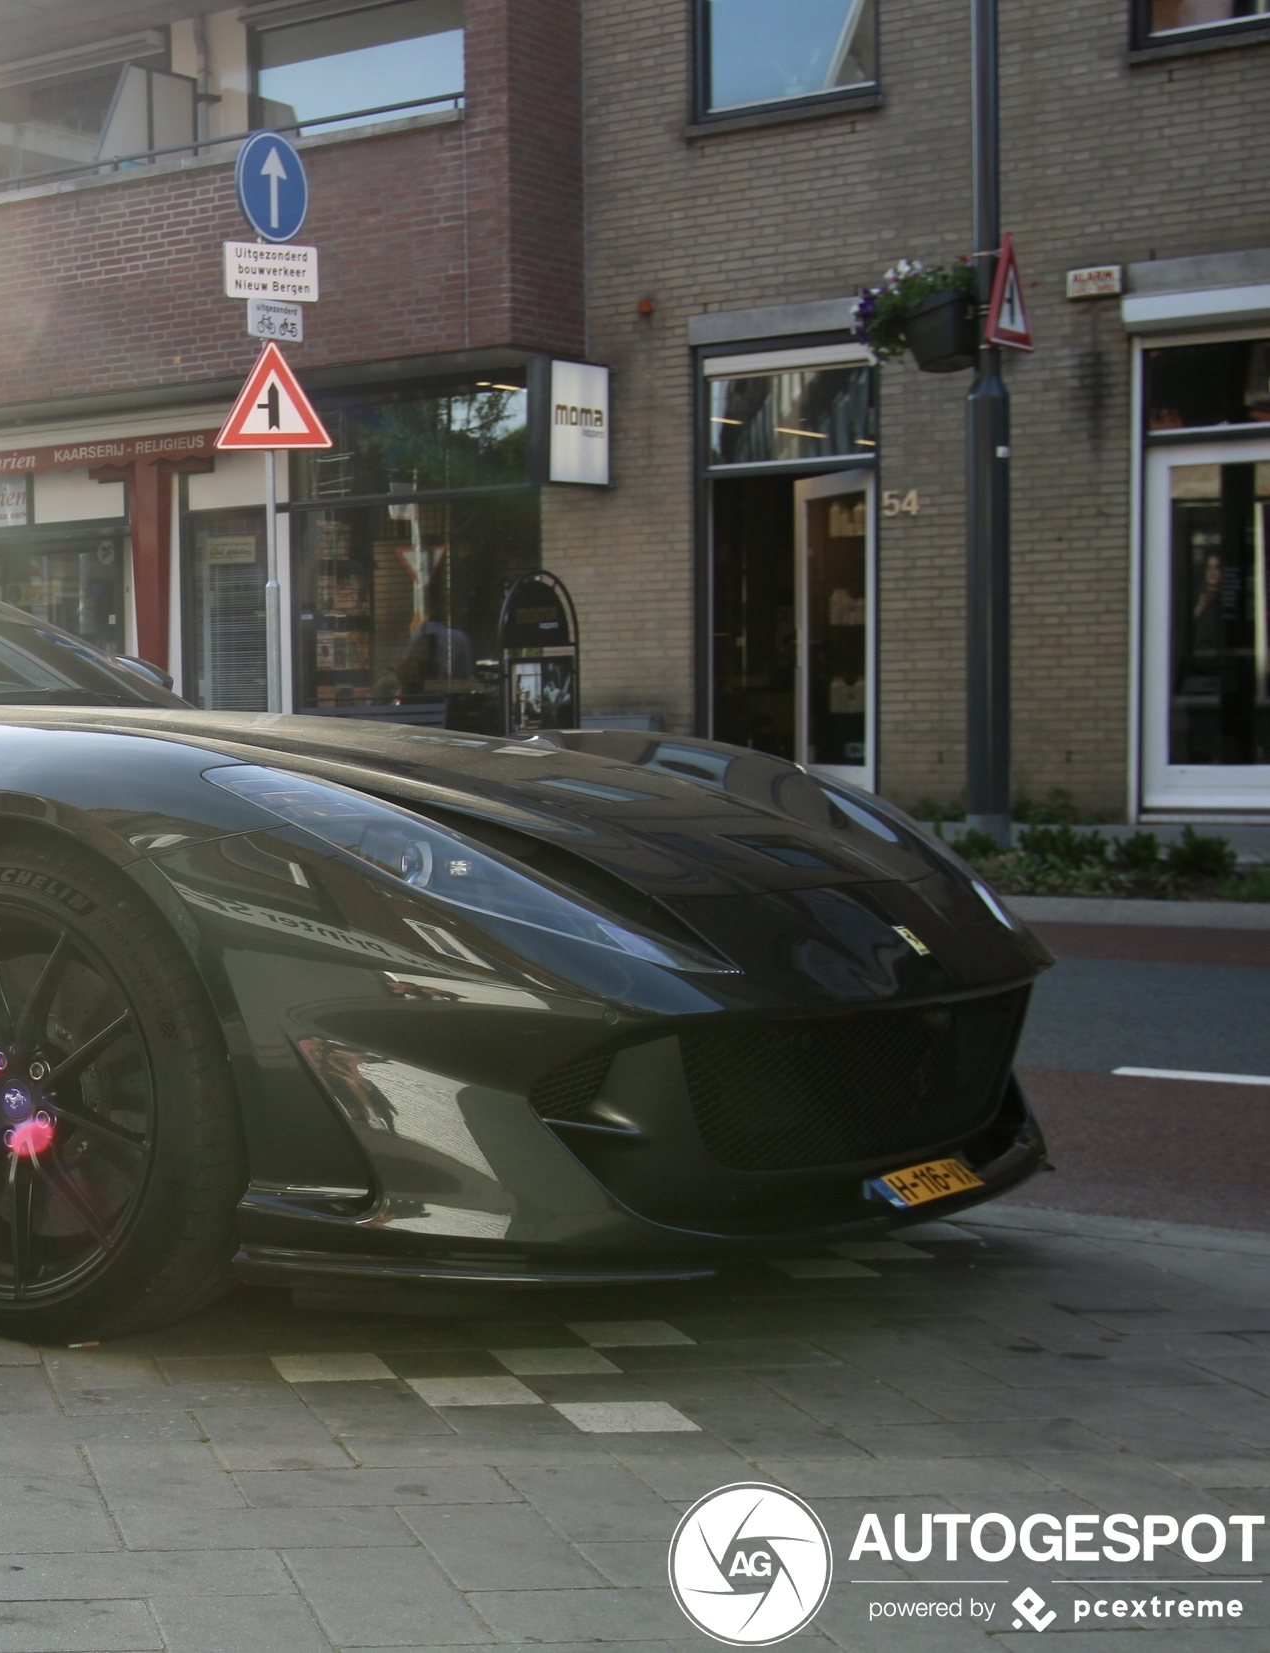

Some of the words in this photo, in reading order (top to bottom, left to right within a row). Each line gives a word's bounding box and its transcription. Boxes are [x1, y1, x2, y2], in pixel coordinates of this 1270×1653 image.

[235, 247, 309, 262] Uitgezonderd
[237, 263, 307, 278] bouwverkeer
[234, 279, 268, 291] Nieuw
[272, 281, 310, 296] Bergen
[256, 303, 298, 316] uitgezonderd
[554, 403, 604, 428] moma
[53, 442, 124, 463] KAARSERIJ
[134, 434, 205, 455] RELIGIEUS
[881, 489, 920, 517] 54
[100, 916, 131, 947] PILOT
[129, 951, 160, 998] SPORT
